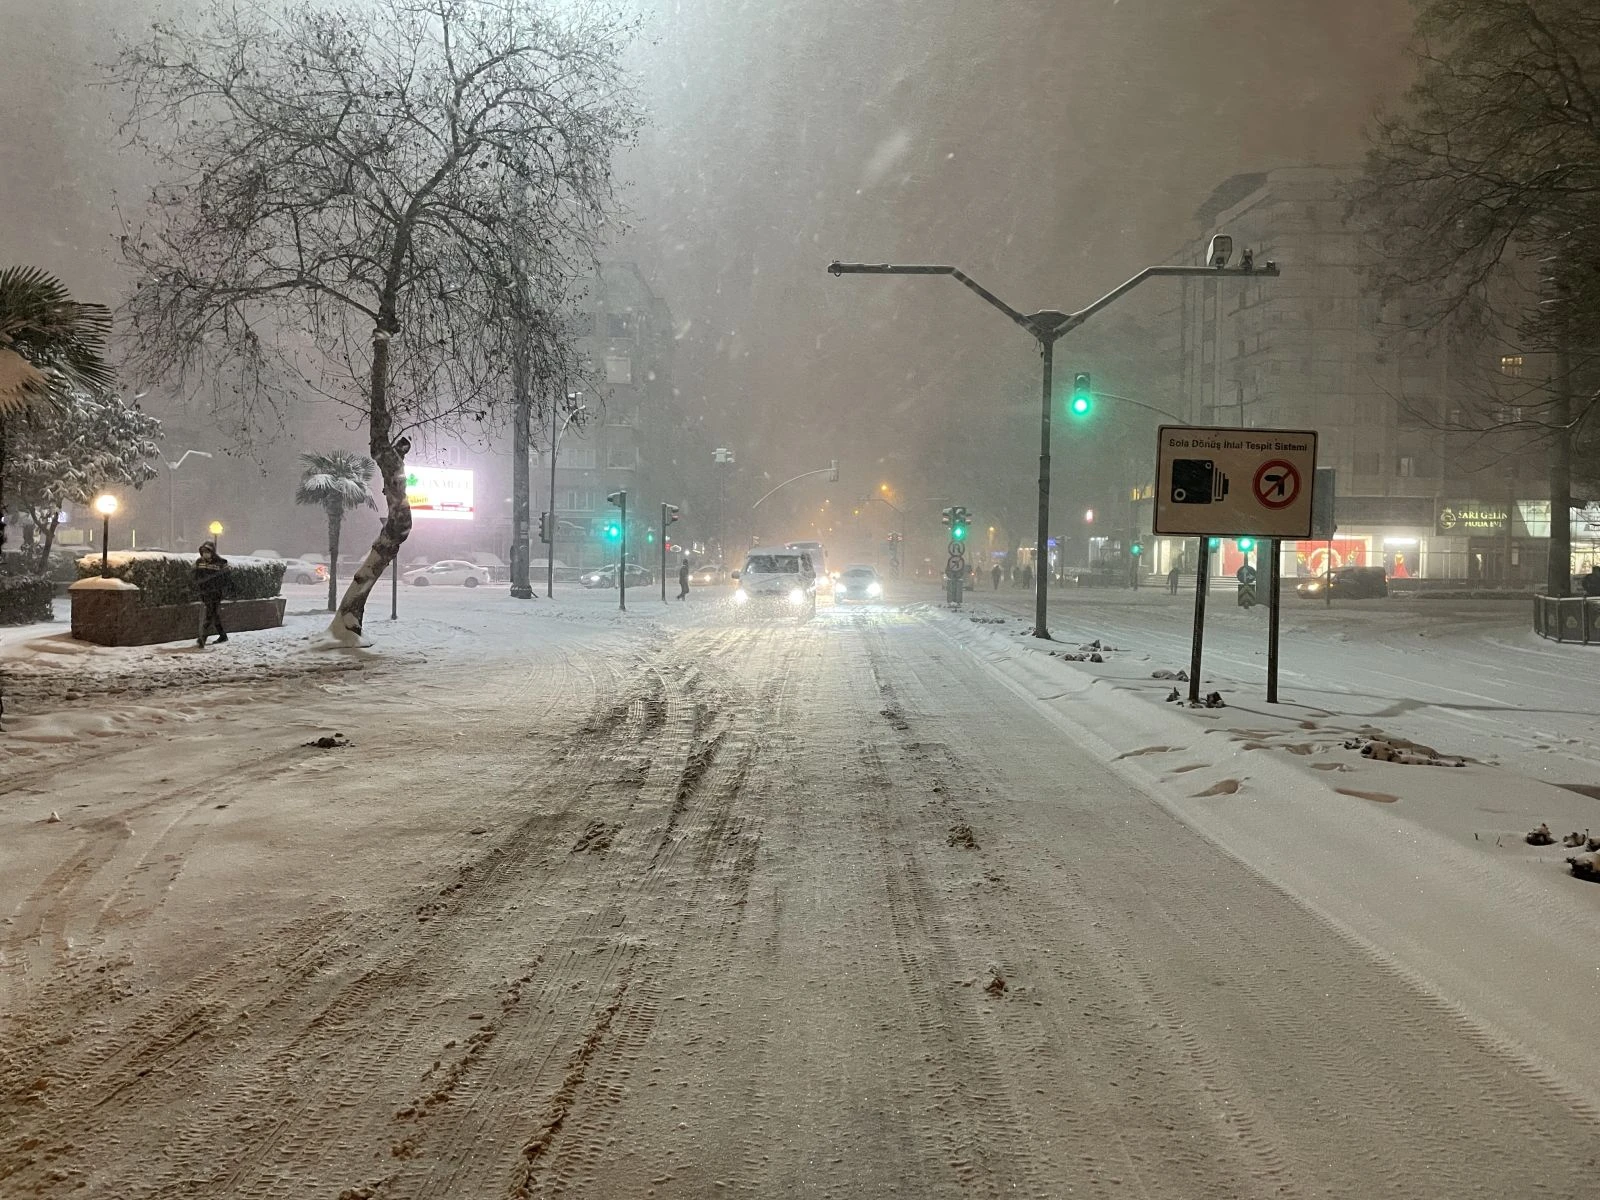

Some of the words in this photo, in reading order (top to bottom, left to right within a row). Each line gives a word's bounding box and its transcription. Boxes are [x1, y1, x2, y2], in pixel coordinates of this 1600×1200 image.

[1169, 438, 1190, 448] Sola
[1191, 439, 1221, 451] Dönüş
[1246, 441, 1272, 452] Tespit
[1274, 442, 1308, 451] Sistemi
